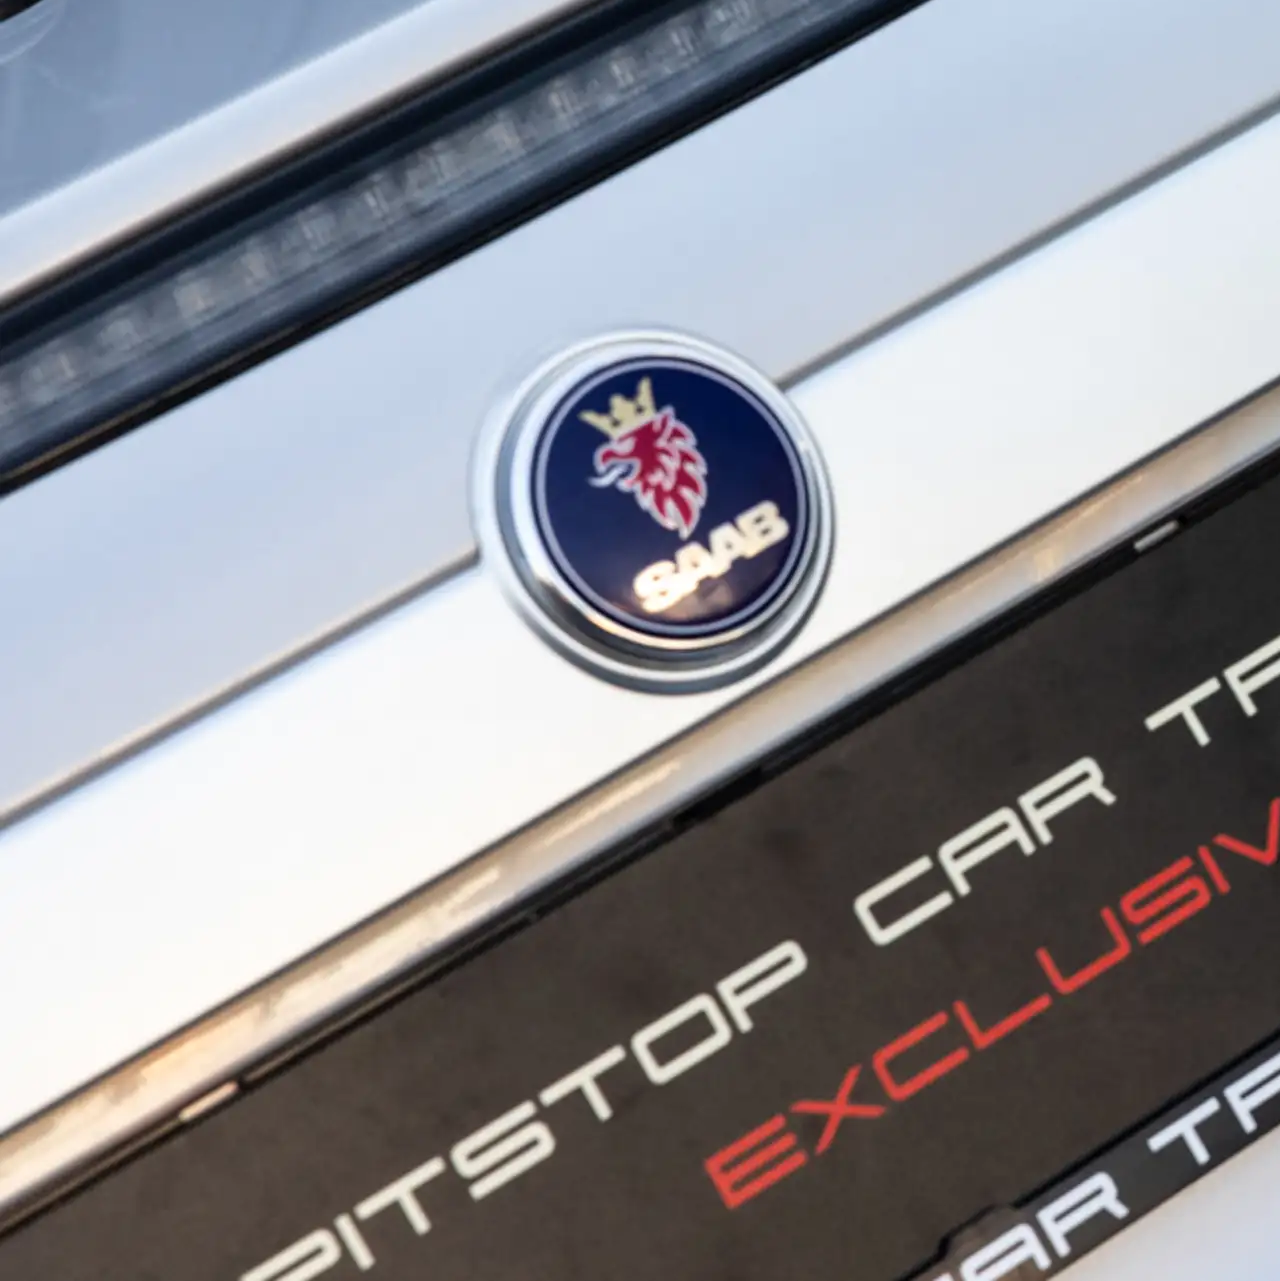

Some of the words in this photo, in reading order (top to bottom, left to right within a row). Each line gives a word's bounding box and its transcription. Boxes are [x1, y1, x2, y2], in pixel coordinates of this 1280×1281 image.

[632, 500, 790, 613] SAAB
[240, 940, 808, 1281] PITSTOP
[853, 756, 1117, 945] CAR
[933, 1171, 1130, 1281] AR
